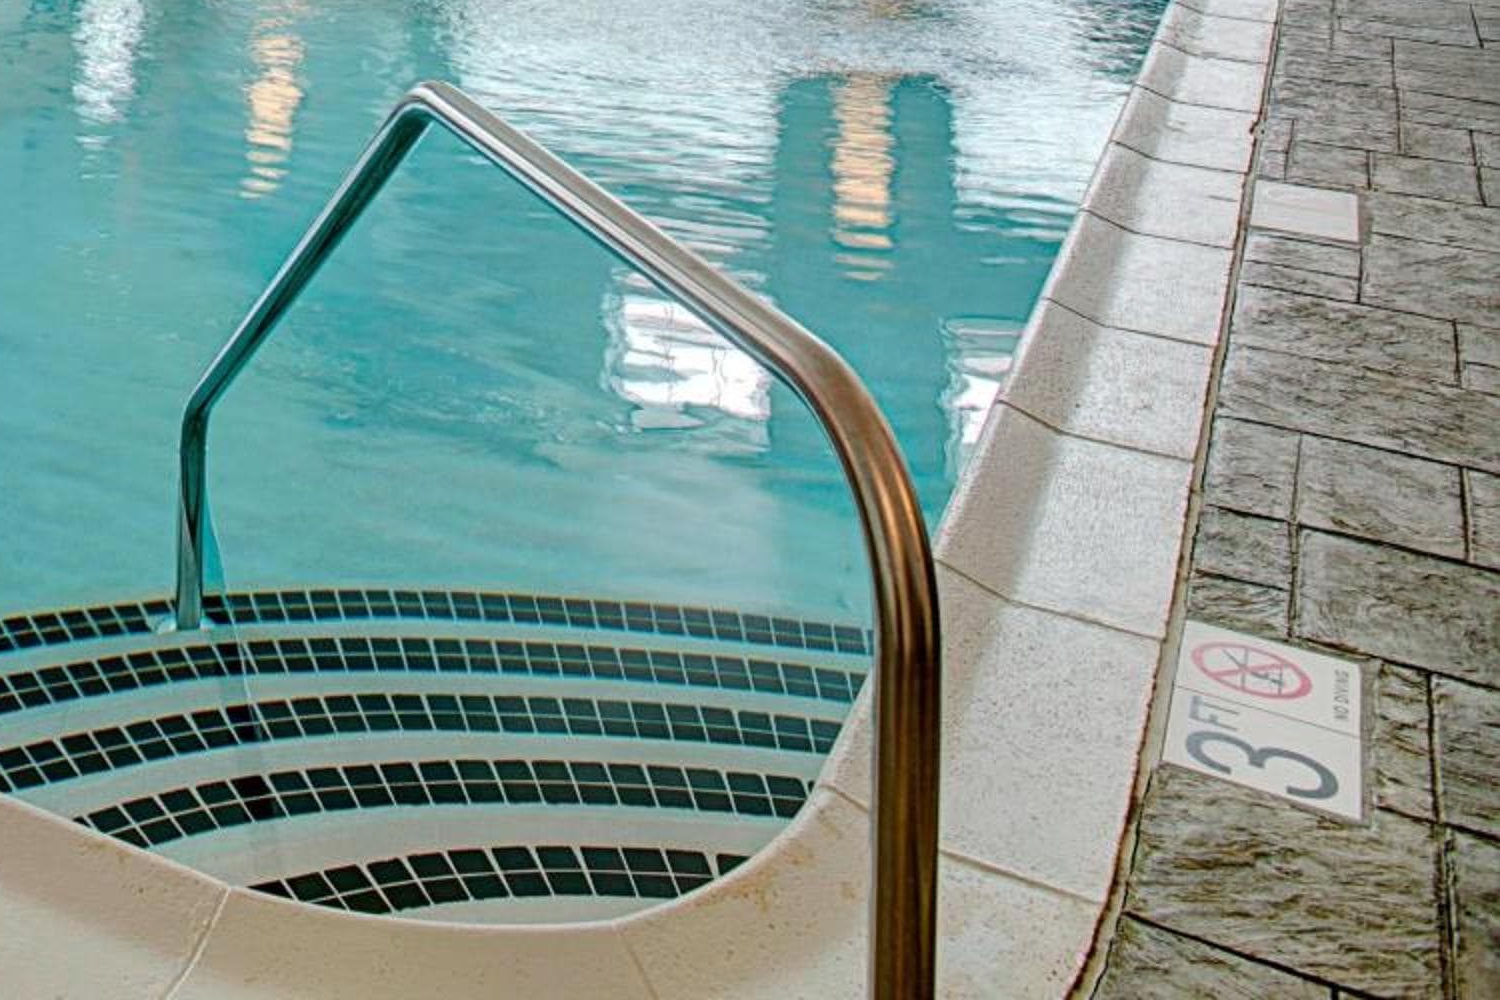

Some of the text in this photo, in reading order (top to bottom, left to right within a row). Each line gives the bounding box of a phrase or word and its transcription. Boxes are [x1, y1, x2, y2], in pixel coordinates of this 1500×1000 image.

[1332, 668, 1349, 720] NO DIVING
[1186, 696, 1339, 800] 3 FT
